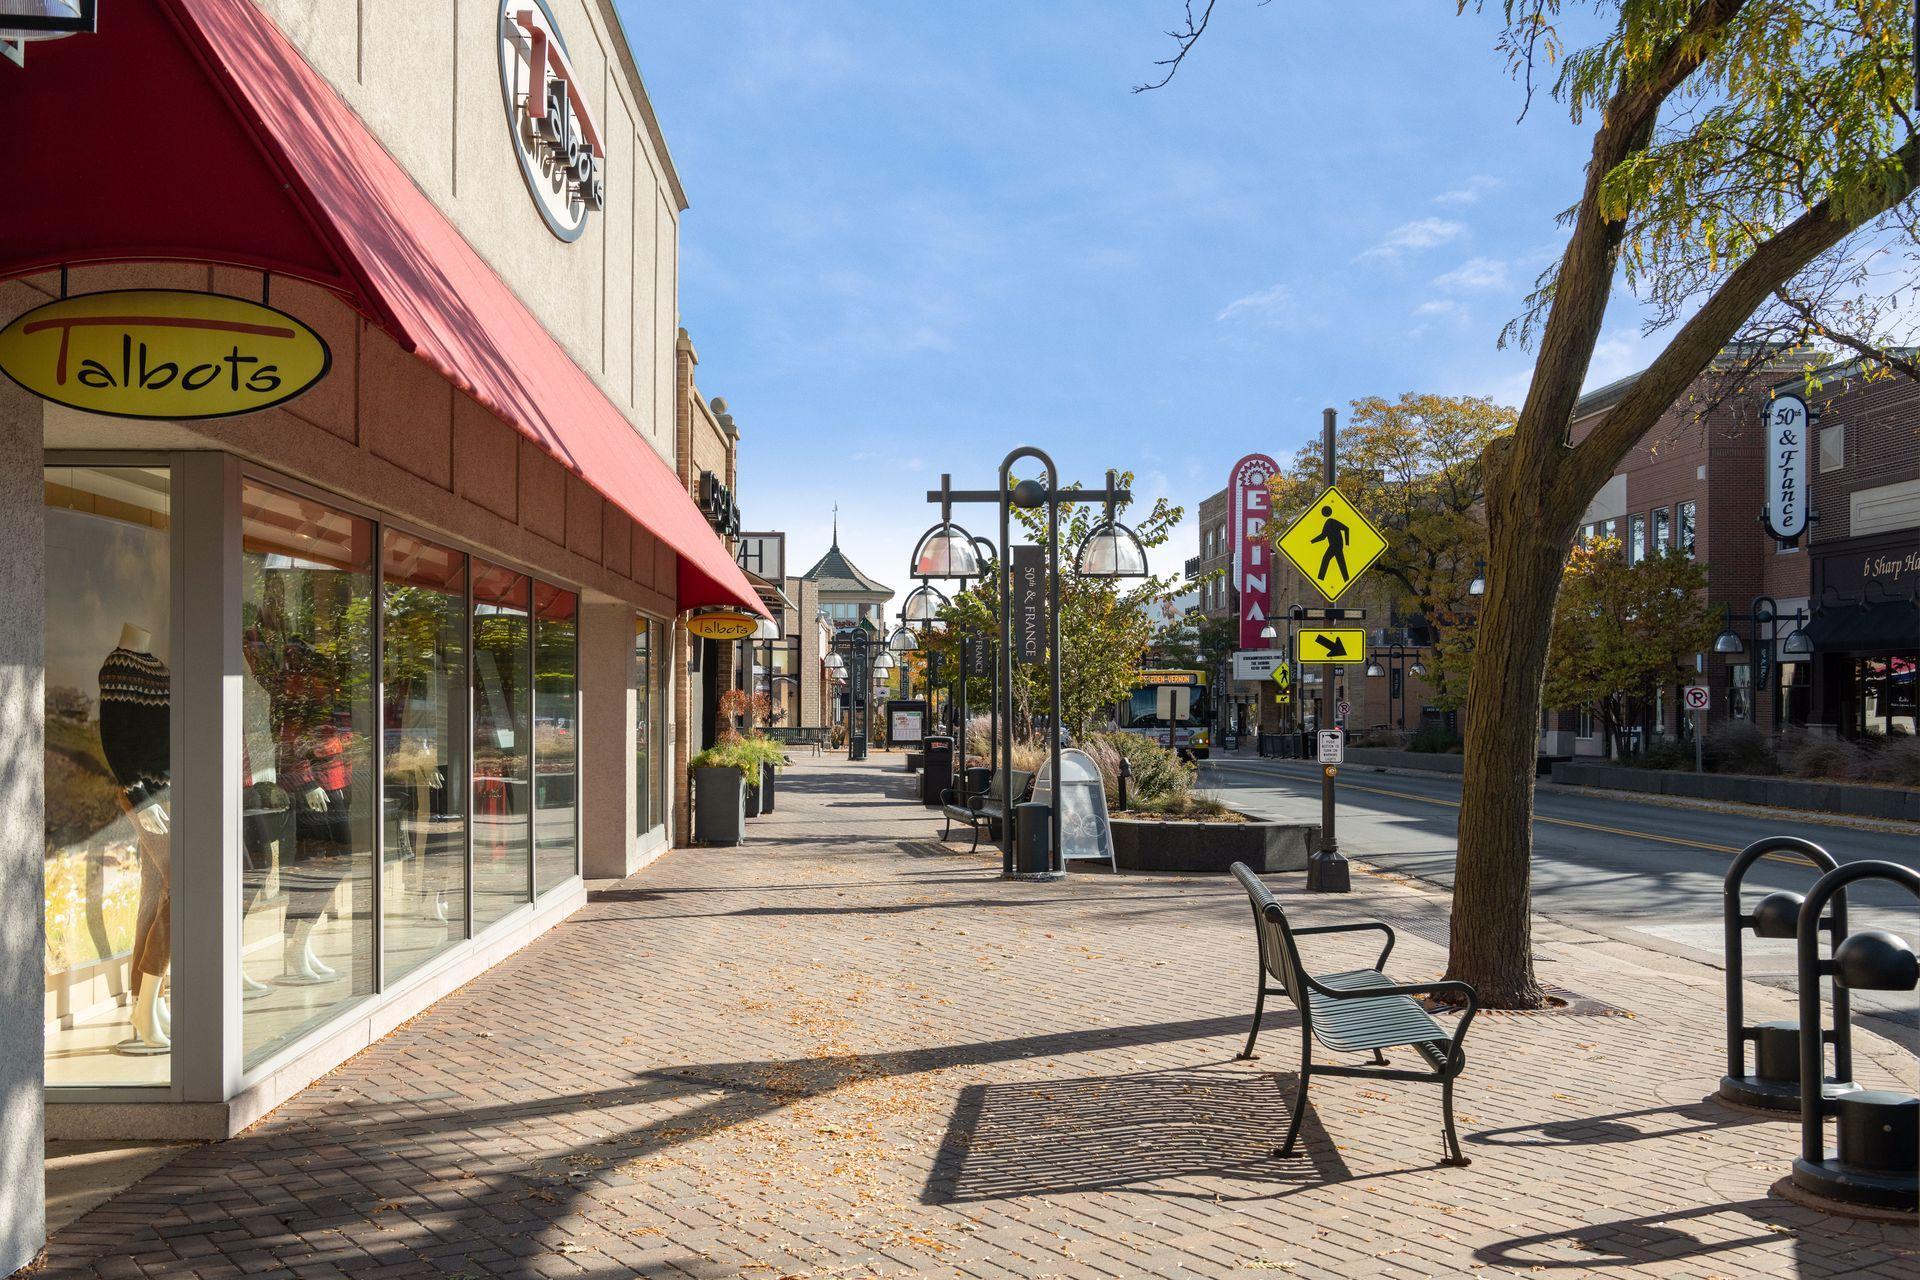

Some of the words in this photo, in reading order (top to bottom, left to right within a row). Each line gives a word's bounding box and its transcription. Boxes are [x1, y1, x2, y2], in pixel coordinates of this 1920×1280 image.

[516, 10, 605, 212] Talbots
[23, 316, 295, 392] Talbots
[1774, 407, 1802, 426] 50th
[1779, 430, 1798, 446] &
[1778, 449, 1798, 528] France
[1246, 489, 1267, 622] EDINA
[1872, 555, 1902, 581] Sharp
[1024, 566, 1036, 588] 50th
[1024, 590, 1036, 604] &
[692, 616, 754, 634] Talbots
[1024, 606, 1037, 657] FRANCE
[975, 640, 983, 674] FRANCE
[1150, 675, 1190, 683] EDEN-VERNON
